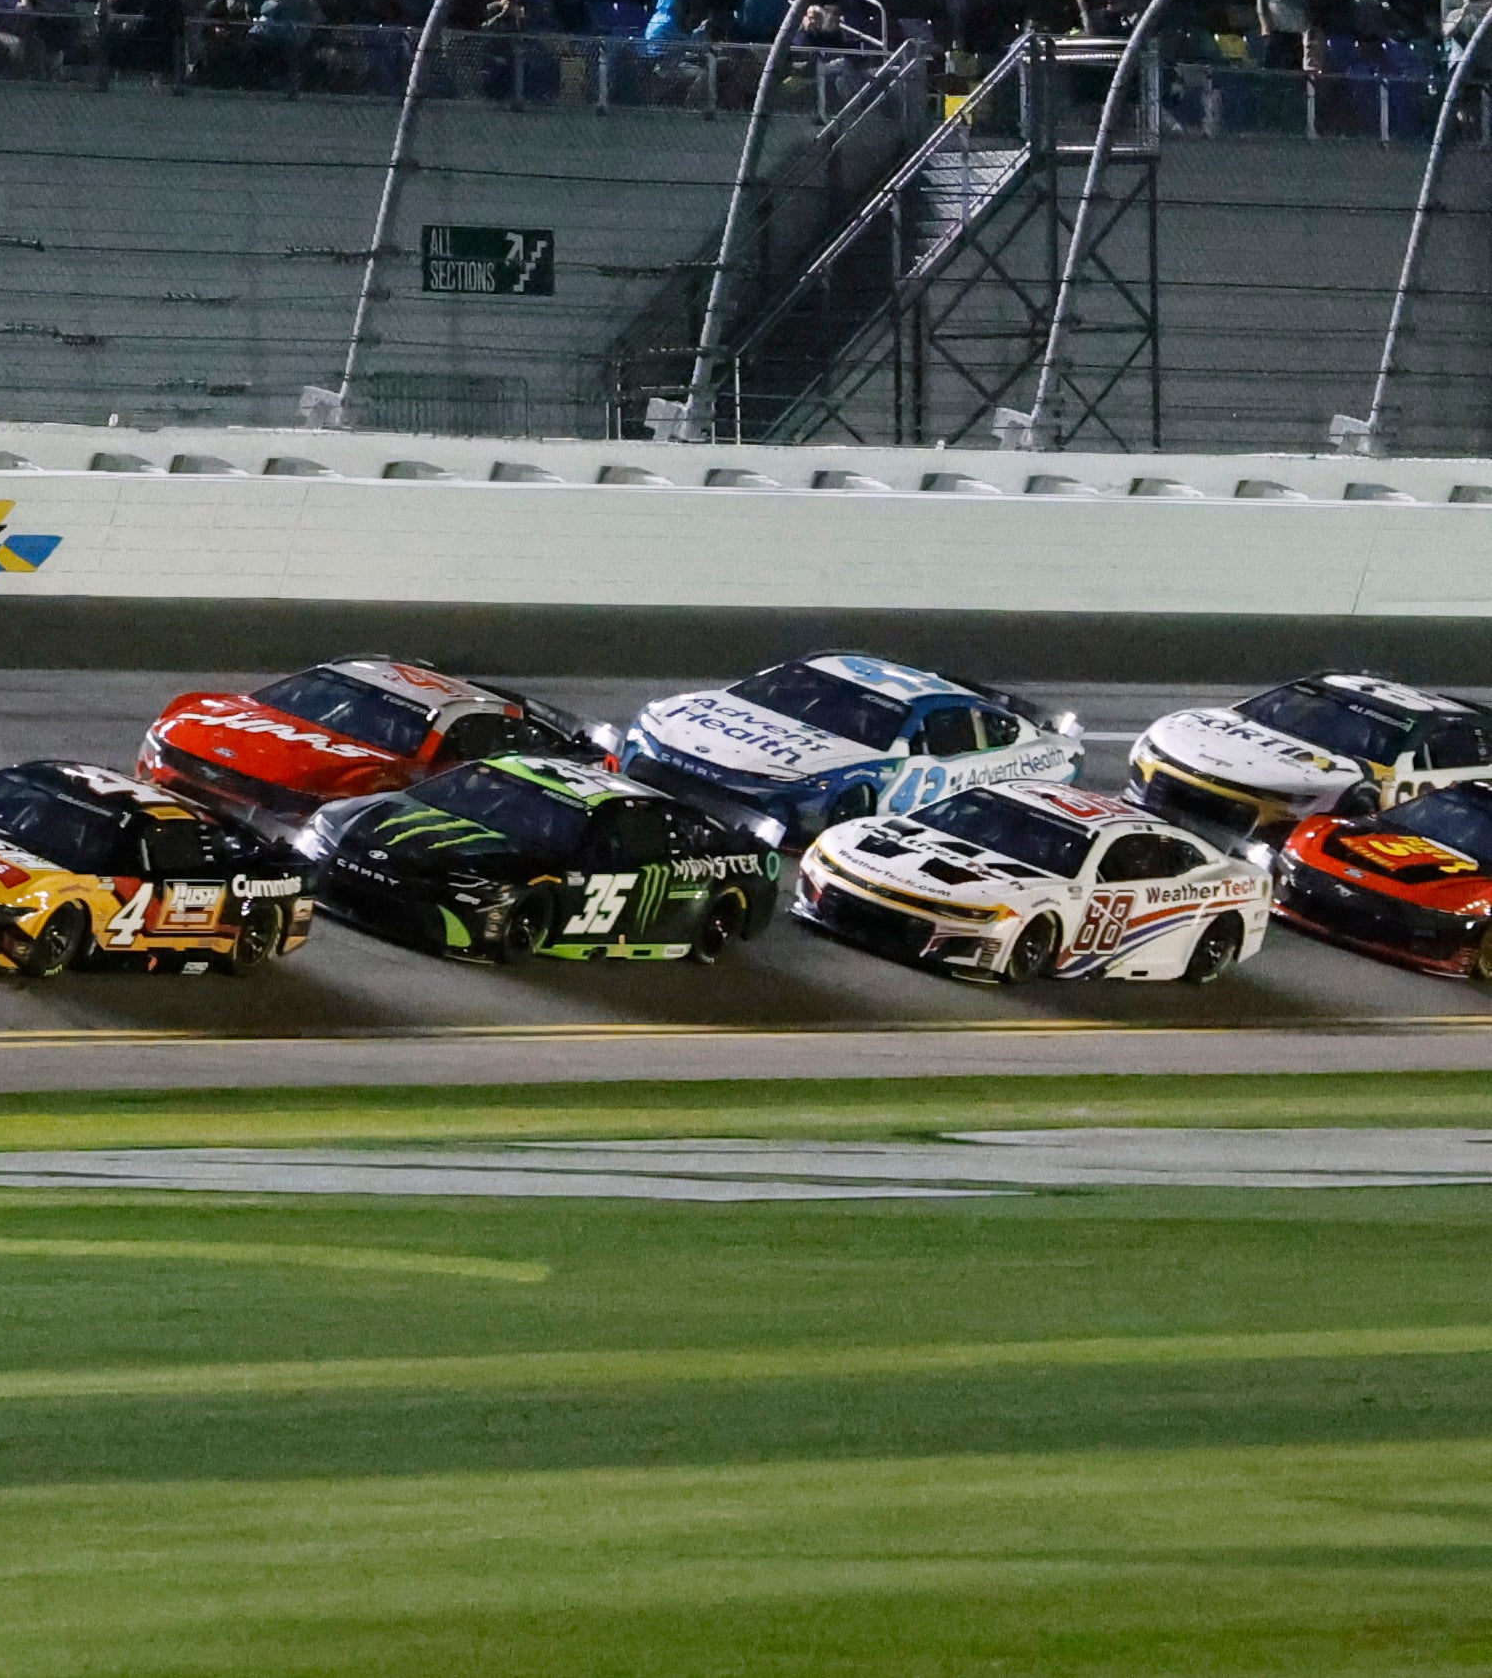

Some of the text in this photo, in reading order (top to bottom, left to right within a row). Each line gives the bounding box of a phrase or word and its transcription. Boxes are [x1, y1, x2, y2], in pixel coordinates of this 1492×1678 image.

[430, 227, 452, 257] ALL
[430, 260, 496, 292] SECTIONS
[665, 706, 804, 765] Health
[336, 857, 400, 887] CAMRY
[670, 853, 764, 882] MONSTER
[838, 849, 952, 898] WeatherTech.com
[232, 872, 302, 898] Cummins
[1145, 874, 1258, 905] WeatherTech
[105, 882, 155, 946] 4
[562, 873, 640, 935] 35
[1071, 890, 1137, 955] 88
